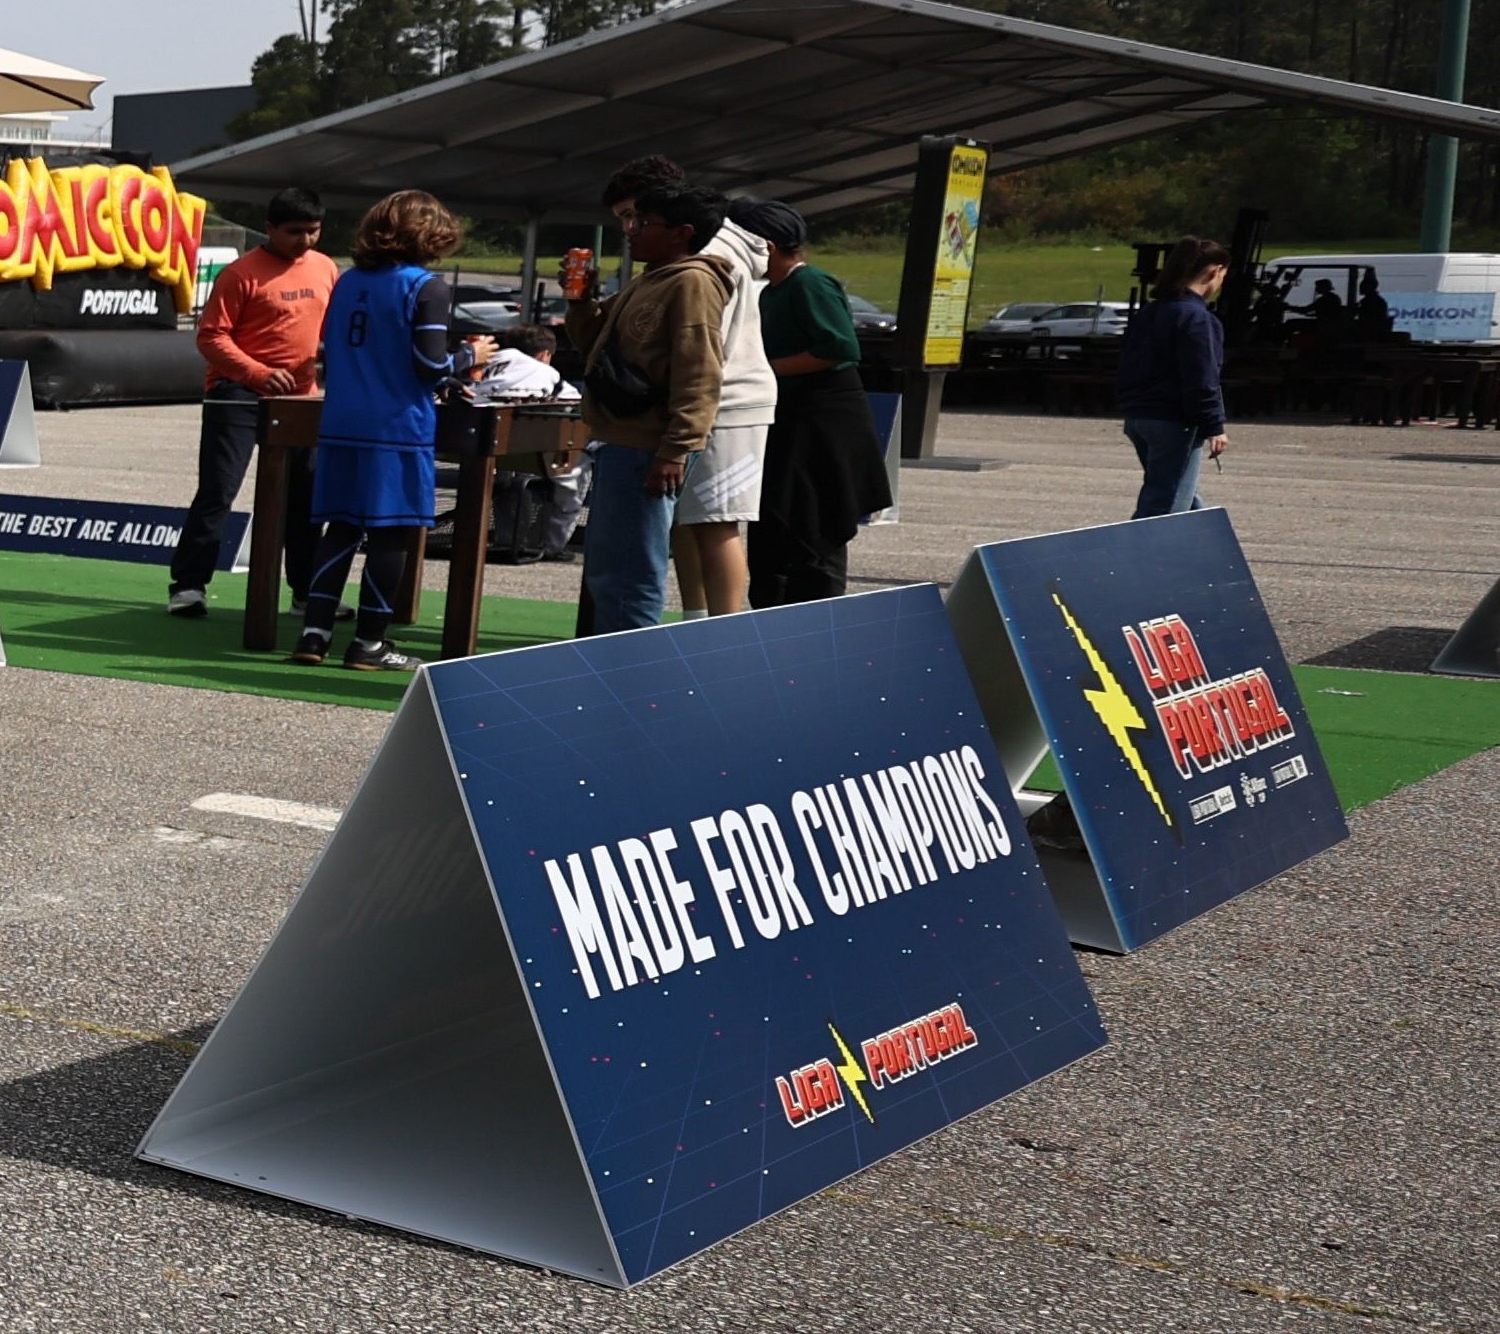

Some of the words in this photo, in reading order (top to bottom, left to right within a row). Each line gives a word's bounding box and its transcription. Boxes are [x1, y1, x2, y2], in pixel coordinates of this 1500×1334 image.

[80, 289, 158, 315] PORTUGAL
[348, 310, 368, 347] 8
[1387, 307, 1477, 320] OMICCON
[28, 515, 80, 538] BEST
[78, 520, 119, 542] ARE
[119, 523, 183, 548] ALLOW
[1122, 613, 1211, 701] LIGA
[1153, 668, 1295, 779] PORTUGAL
[544, 828, 716, 999] MADE
[690, 804, 814, 950] FOR
[791, 744, 1011, 915] CHAMPIONS
[775, 1058, 845, 1128] LIGA
[861, 1003, 978, 1090] PORTUGAL
